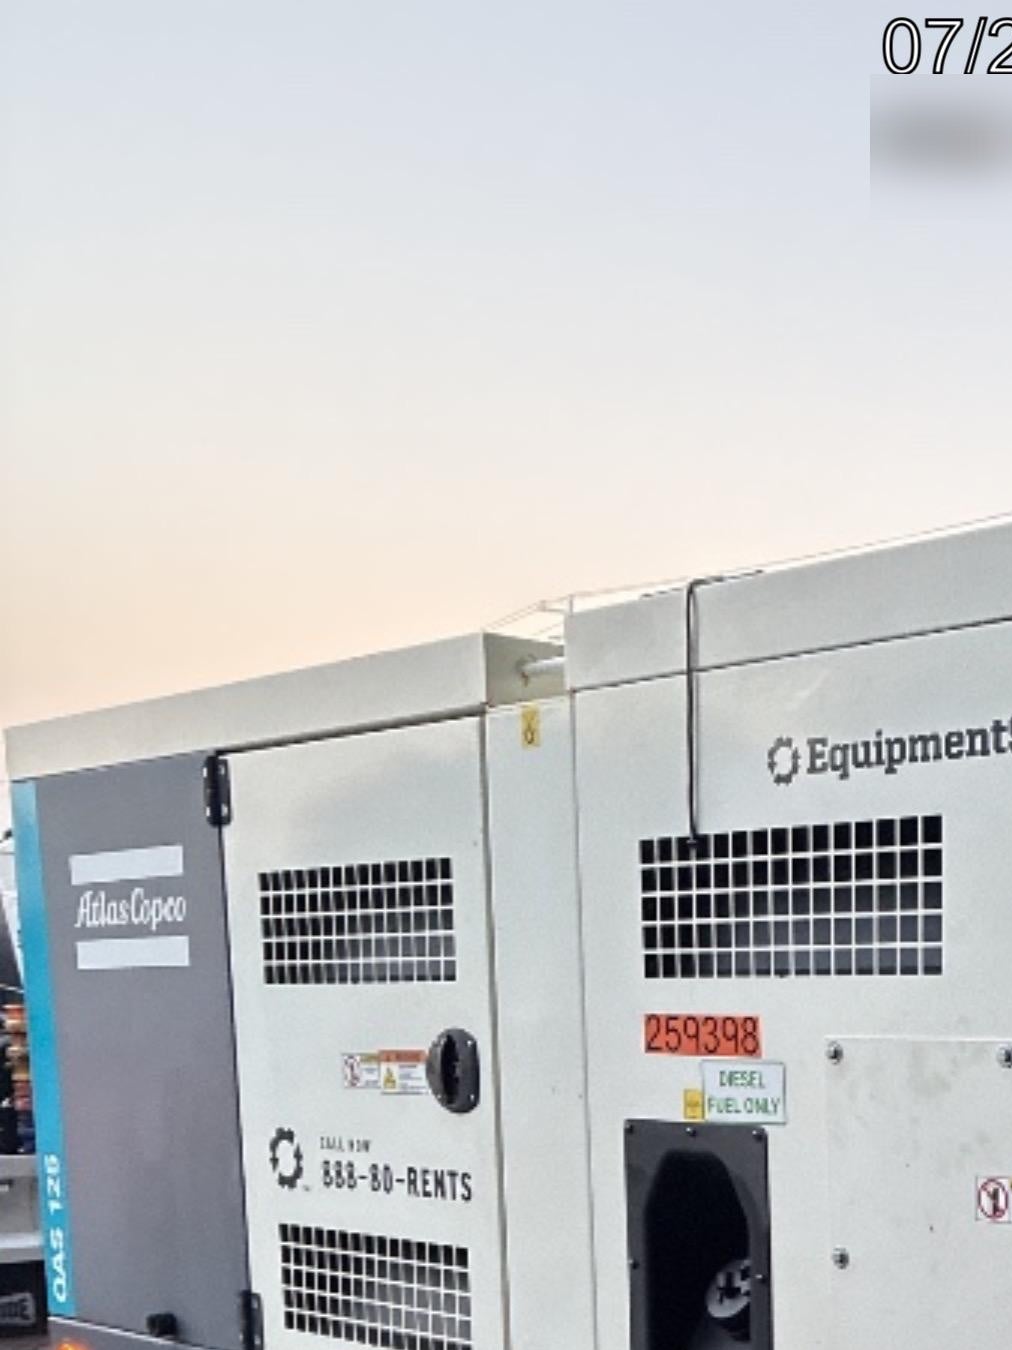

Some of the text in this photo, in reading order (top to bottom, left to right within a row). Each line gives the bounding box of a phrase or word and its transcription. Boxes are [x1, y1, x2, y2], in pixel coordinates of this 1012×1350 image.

[646, 1014, 759, 1054] 259398
[719, 1070, 765, 1089] DIESEL
[707, 1096, 781, 1115] FUEL ONLY
[321, 1159, 473, 1202] 888-80-RENTS
